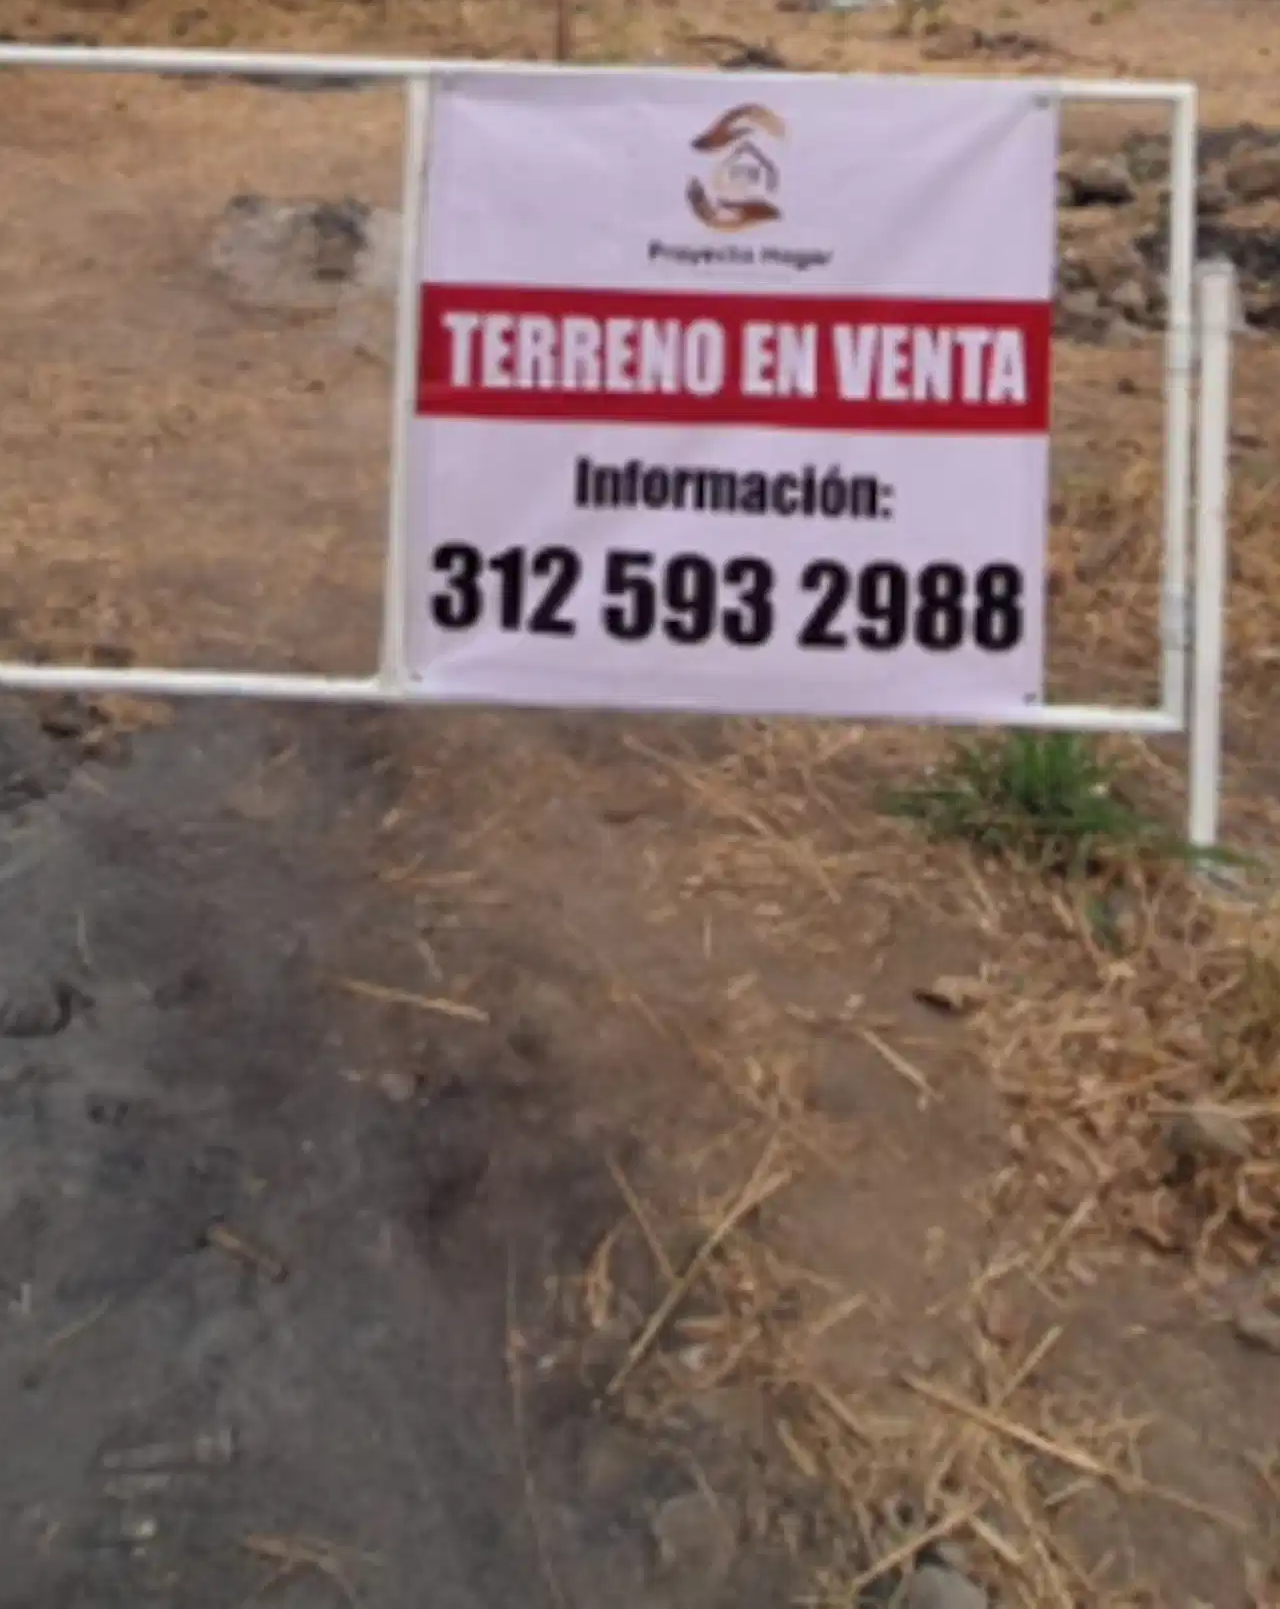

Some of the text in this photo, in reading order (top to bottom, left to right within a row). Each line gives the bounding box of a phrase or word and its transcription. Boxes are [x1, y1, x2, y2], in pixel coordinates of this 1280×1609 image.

[442, 311, 1027, 405] TERRENO EN VENTA
[573, 455, 896, 521] Información:
[430, 541, 1024, 654] 312 593 2988
